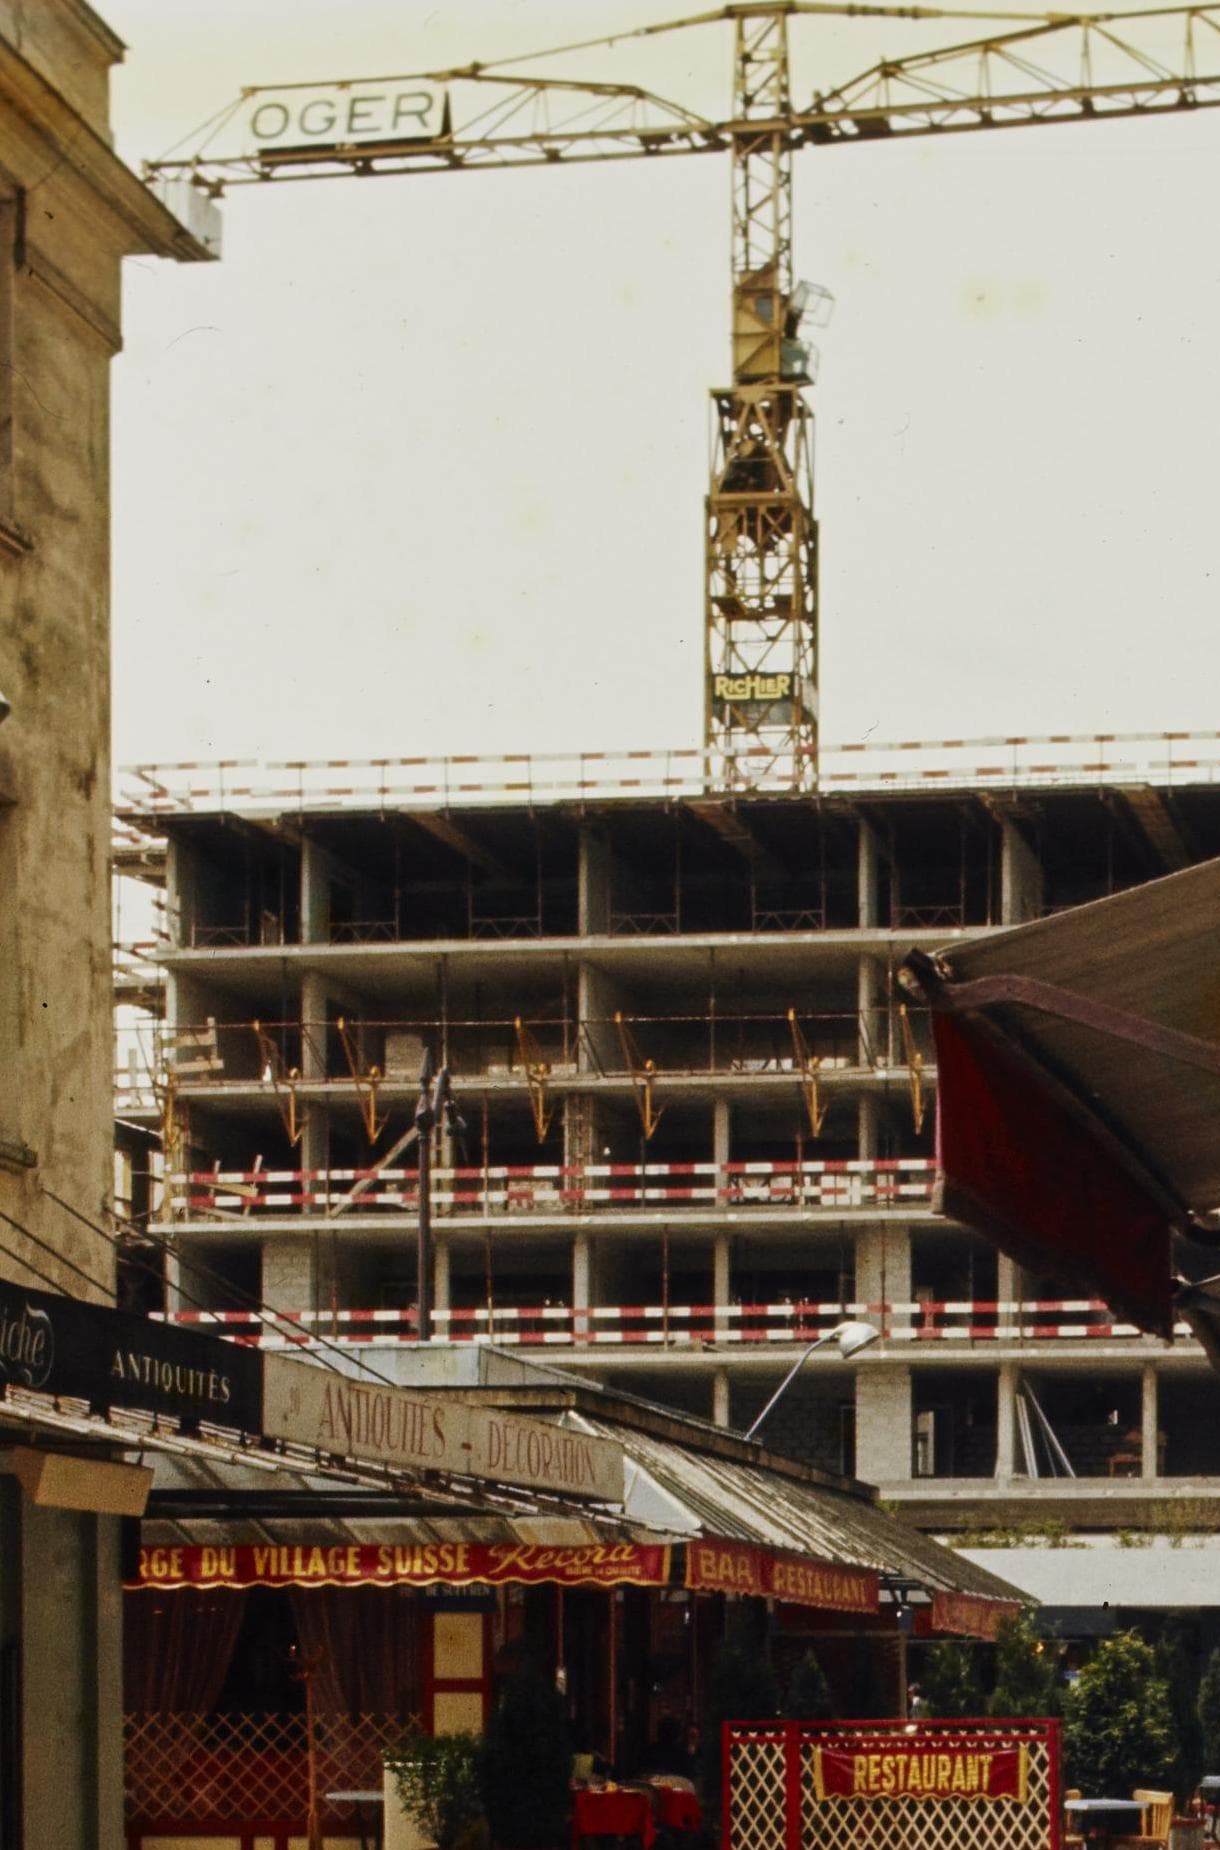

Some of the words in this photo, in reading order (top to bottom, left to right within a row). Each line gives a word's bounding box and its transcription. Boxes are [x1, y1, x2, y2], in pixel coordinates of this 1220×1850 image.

[250, 90, 434, 140] OGER
[715, 674, 791, 700] RICHIER
[111, 1349, 231, 1404] ANTIQUITÉS
[319, 1377, 447, 1459] ANTIQUITÉS
[201, 1547, 236, 1578] DU
[253, 1546, 361, 1577] VILLAGE
[376, 1543, 470, 1576] SUISSE
[700, 1548, 753, 1585] BAR
[771, 1560, 867, 1603] RESTAURANT
[853, 1753, 993, 1791] RESTAURANT
